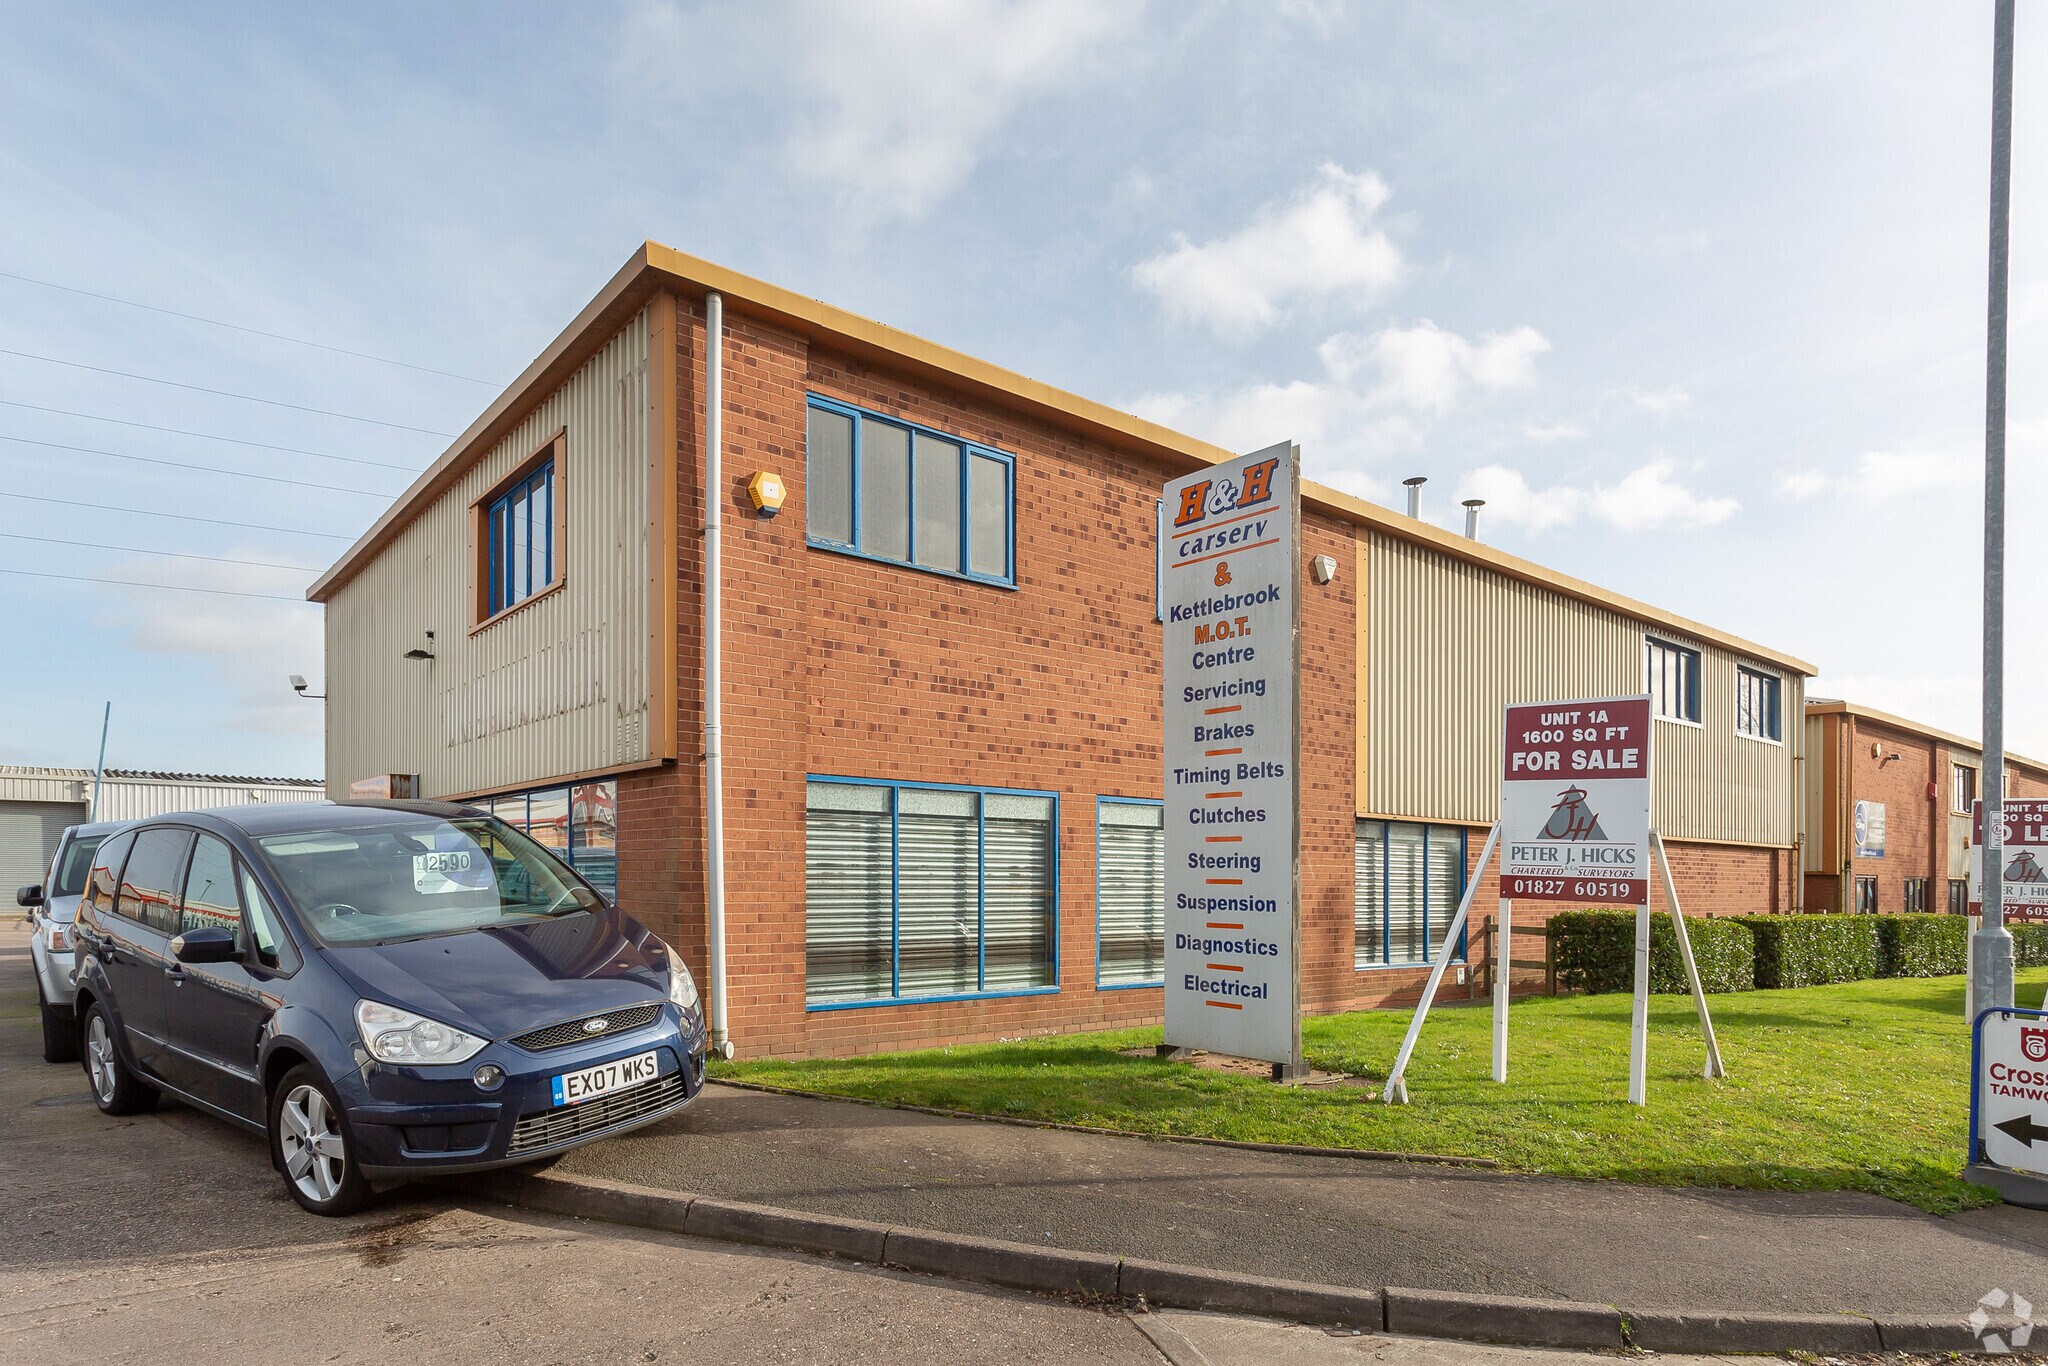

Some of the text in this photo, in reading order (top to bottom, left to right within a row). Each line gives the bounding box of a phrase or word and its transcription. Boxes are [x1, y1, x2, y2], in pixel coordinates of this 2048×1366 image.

[1173, 457, 1280, 529] H&H
[1179, 519, 1268, 557] carserv
[1214, 561, 1233, 587] &
[1170, 583, 1281, 623] Kettlebrook
[1194, 616, 1251, 645] M.O.T.
[1192, 646, 1255, 670] Centre
[1183, 677, 1266, 703] Servicing
[1541, 710, 1609, 726] UNIT 1A
[1193, 722, 1255, 743] Brakes
[1522, 726, 1629, 744] 1600 SQ FT
[1512, 748, 1639, 772] FOR SALE
[1174, 761, 1285, 785] Timing Belts
[1189, 806, 1267, 825] Clutches
[2024, 813, 2043, 822] SQ
[1187, 852, 1261, 873] Steering
[1511, 846, 1636, 865] PETER J. HICKS
[1510, 866, 1635, 878] CHARTERED SURVEYORS
[1514, 879, 1630, 898] 01827 60519
[1176, 893, 1277, 914] Suspension
[1175, 933, 1278, 957] Diagnostics
[1184, 974, 1268, 999] Electrical
[567, 1056, 655, 1098] EX07 WKS
